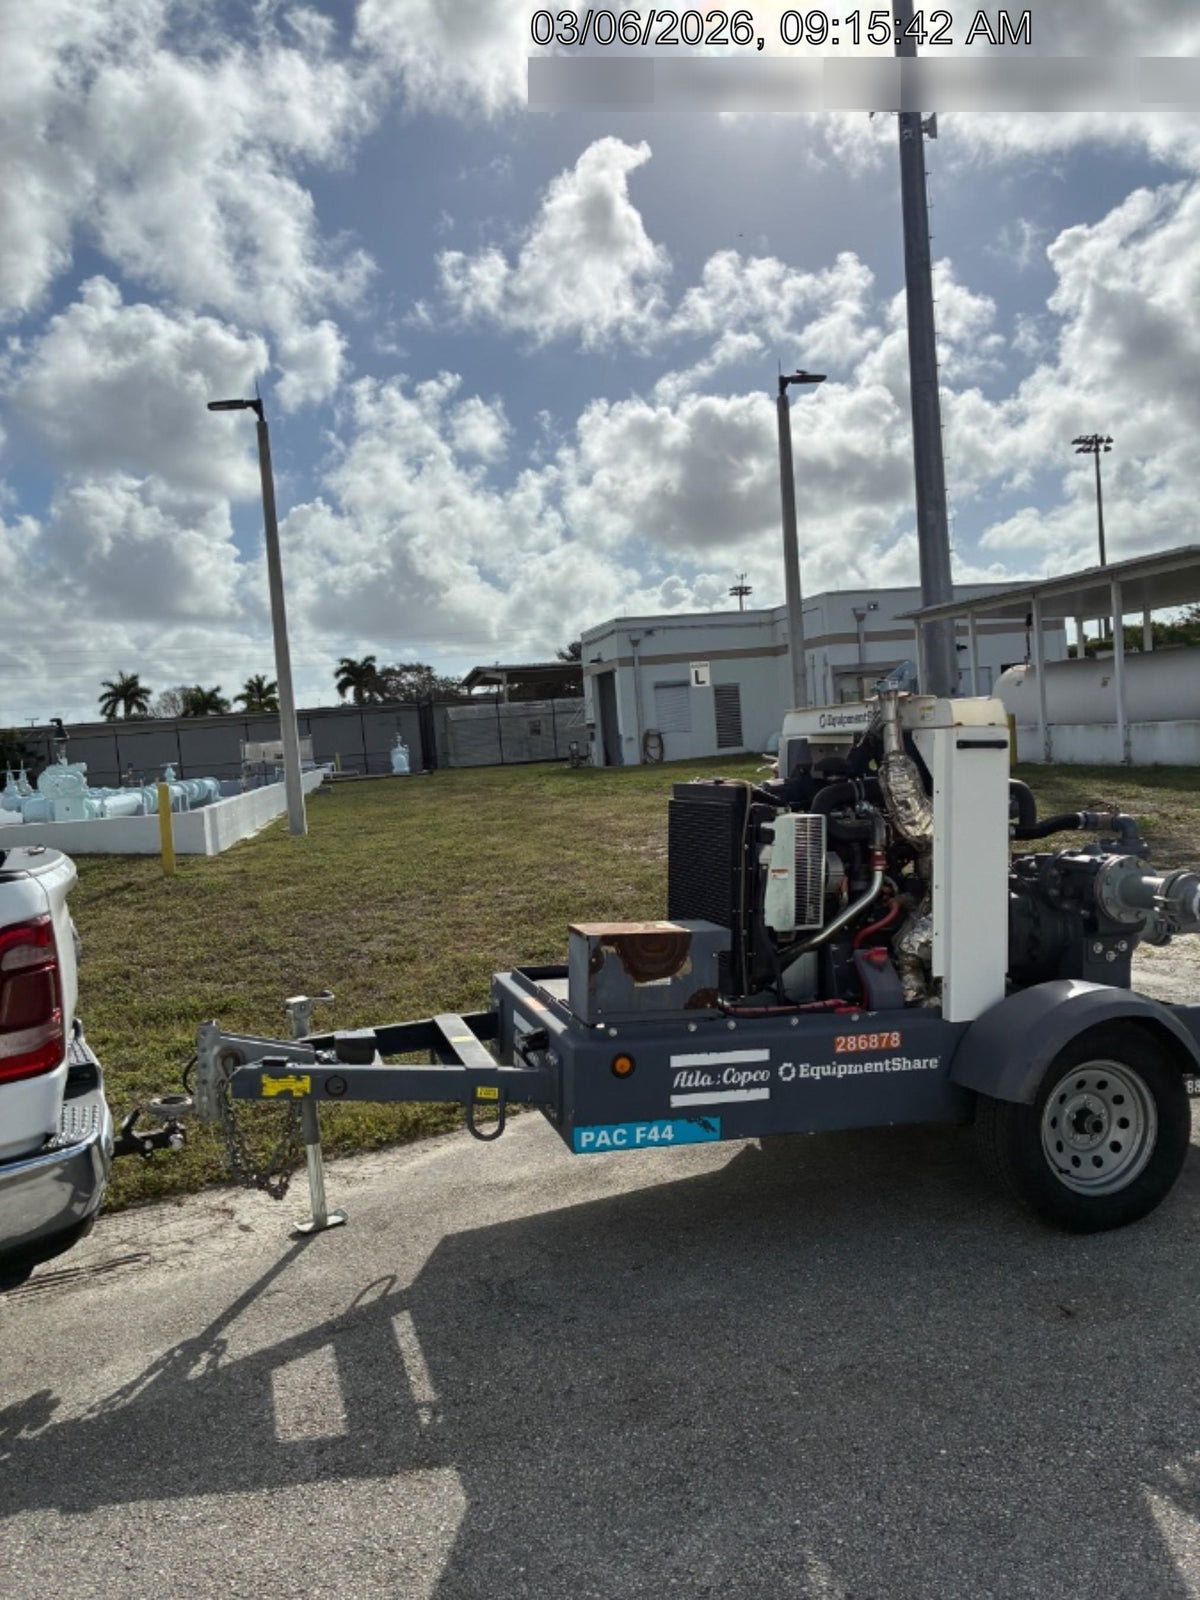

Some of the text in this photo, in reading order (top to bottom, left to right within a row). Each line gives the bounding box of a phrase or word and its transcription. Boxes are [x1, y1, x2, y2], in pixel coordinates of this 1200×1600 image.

[694, 670, 707, 685] L
[835, 1031, 902, 1053] 286878
[722, 1067, 770, 1087] Copco
[798, 1056, 940, 1080] EquipmentShare
[580, 1124, 675, 1148] PAC F44
